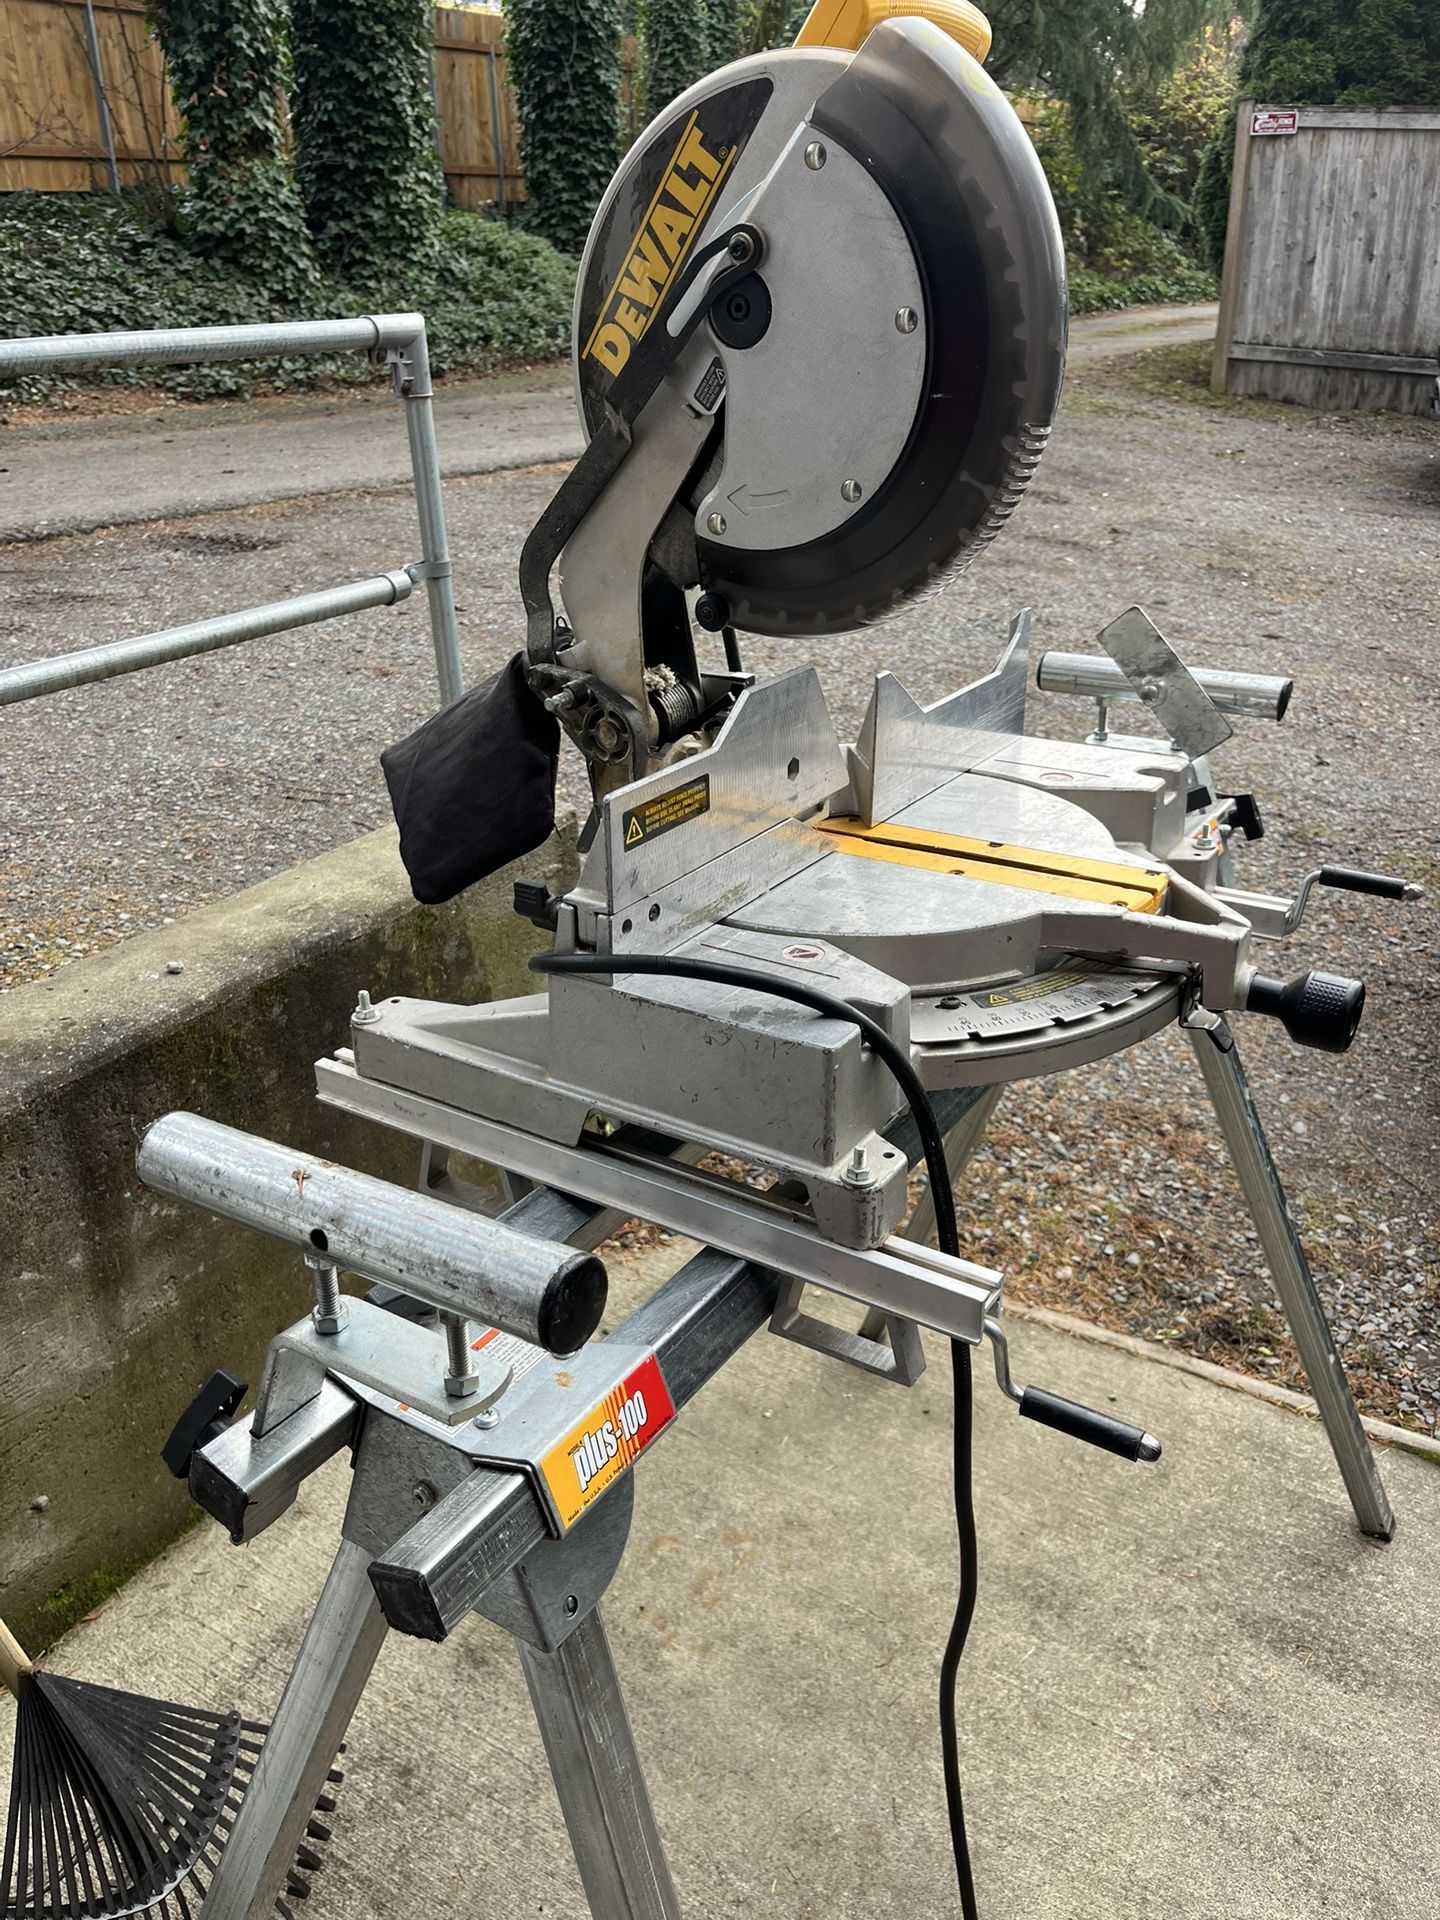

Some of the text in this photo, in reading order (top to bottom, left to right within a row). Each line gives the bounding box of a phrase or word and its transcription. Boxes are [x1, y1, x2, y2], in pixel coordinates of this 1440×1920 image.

[590, 125, 722, 377] DEWALT
[645, 783, 706, 816] ALWAYS ADJUST FENCE PROPERLY
[645, 813, 660, 825] BEFORE
[668, 802, 682, 814] CLAMP
[682, 797, 694, 807] SMALL
[646, 822, 660, 834] BEFORE
[572, 1390, 648, 1493] plus-100
[567, 1509, 580, 1522] Made
